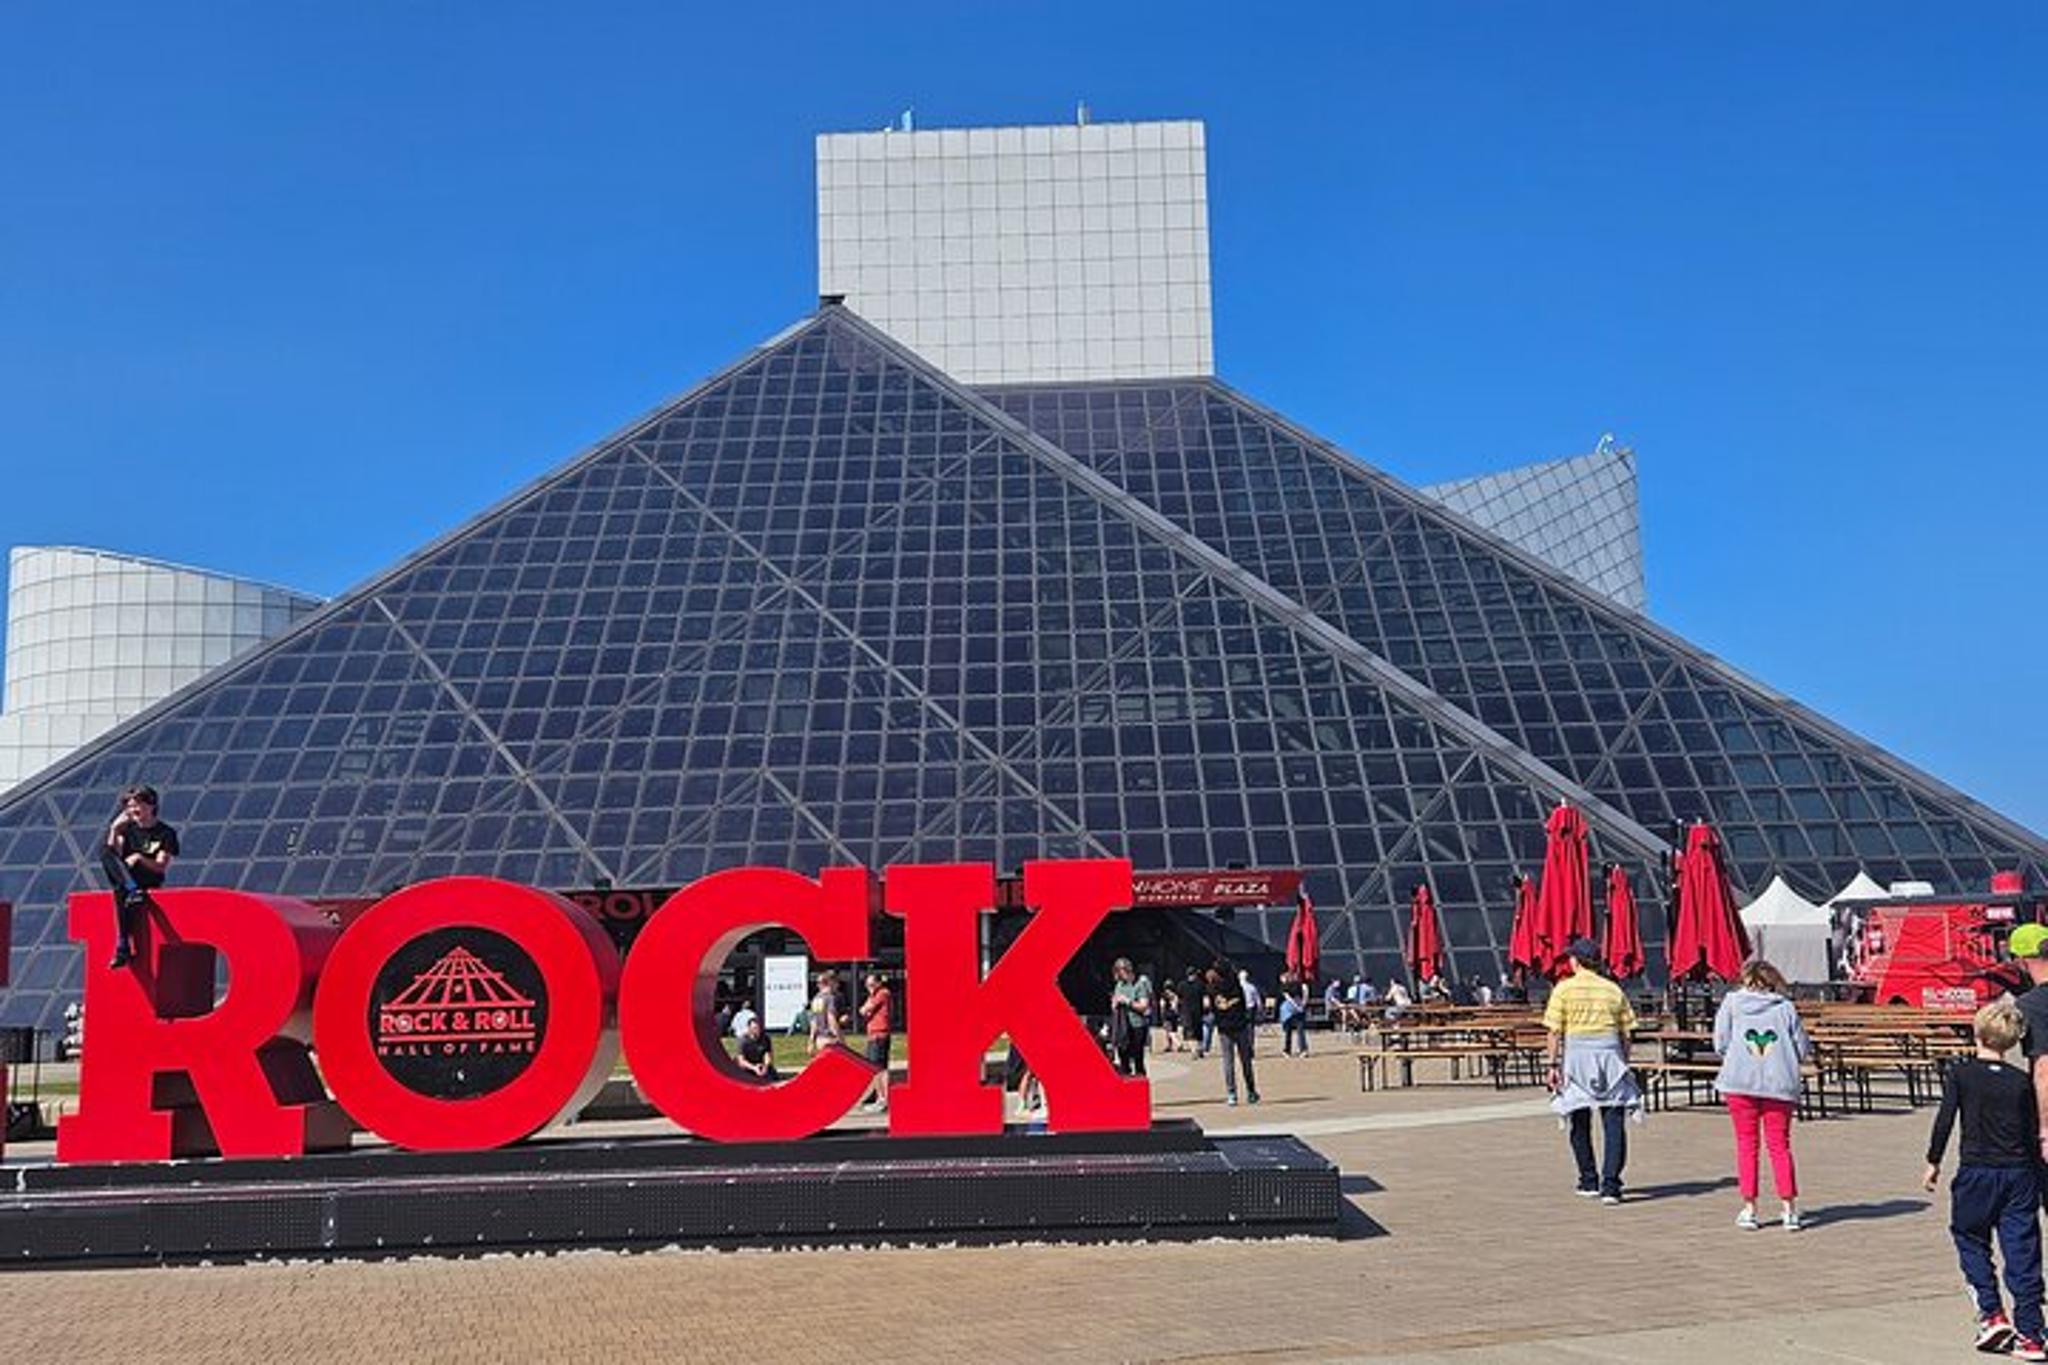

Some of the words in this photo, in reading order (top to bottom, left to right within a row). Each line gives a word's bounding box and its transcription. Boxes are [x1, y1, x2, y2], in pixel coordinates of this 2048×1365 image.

[1213, 883, 1270, 895] PLAZA
[57, 857, 1151, 1165] ROCK
[380, 1012, 447, 1033] ROCK
[452, 1012, 470, 1031] &
[474, 1009, 535, 1030] ROLL
[378, 1044, 431, 1056] HALL
[443, 1043, 468, 1054] OF
[480, 1041, 535, 1053] FAME
